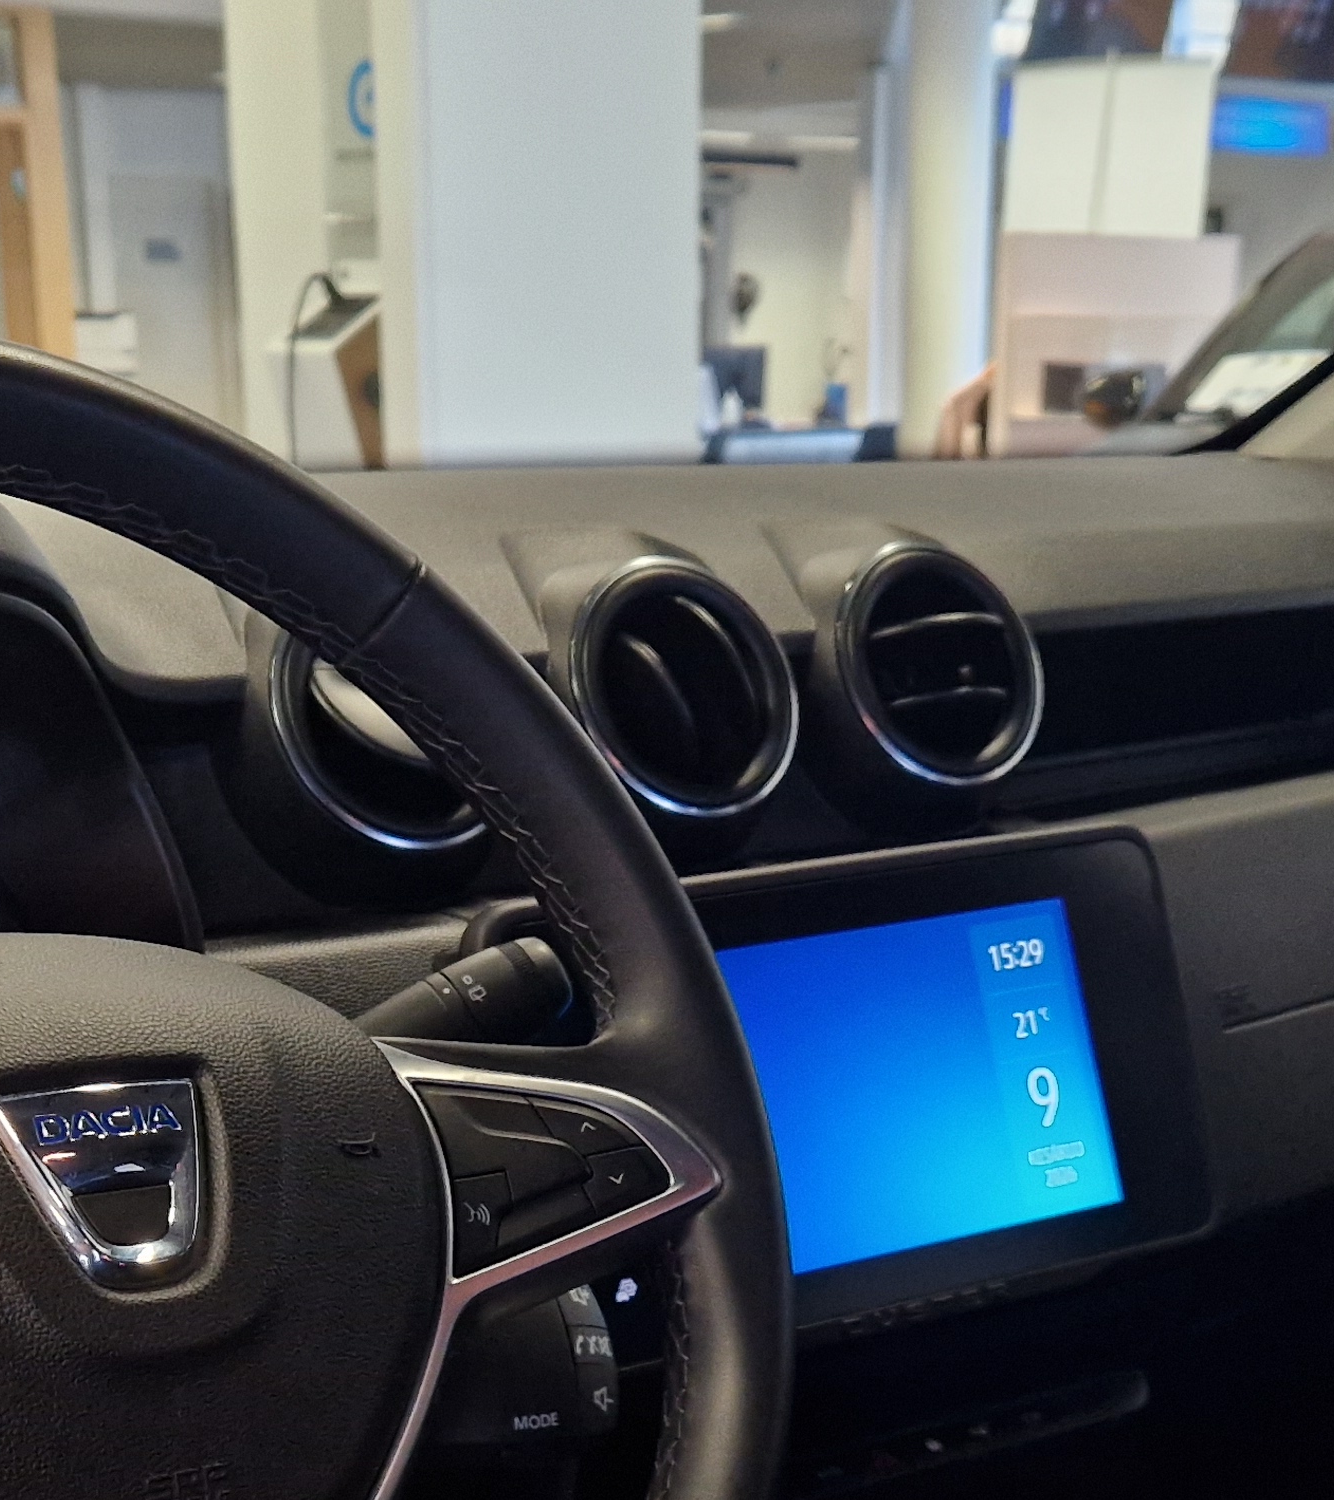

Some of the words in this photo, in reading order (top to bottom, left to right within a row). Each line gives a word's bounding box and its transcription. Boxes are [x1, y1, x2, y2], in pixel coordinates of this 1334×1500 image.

[987, 938, 1044, 972] 15:29
[1026, 1066, 1060, 1127] 9
[32, 1103, 182, 1146] DACIA
[513, 1411, 559, 1430] MODE
